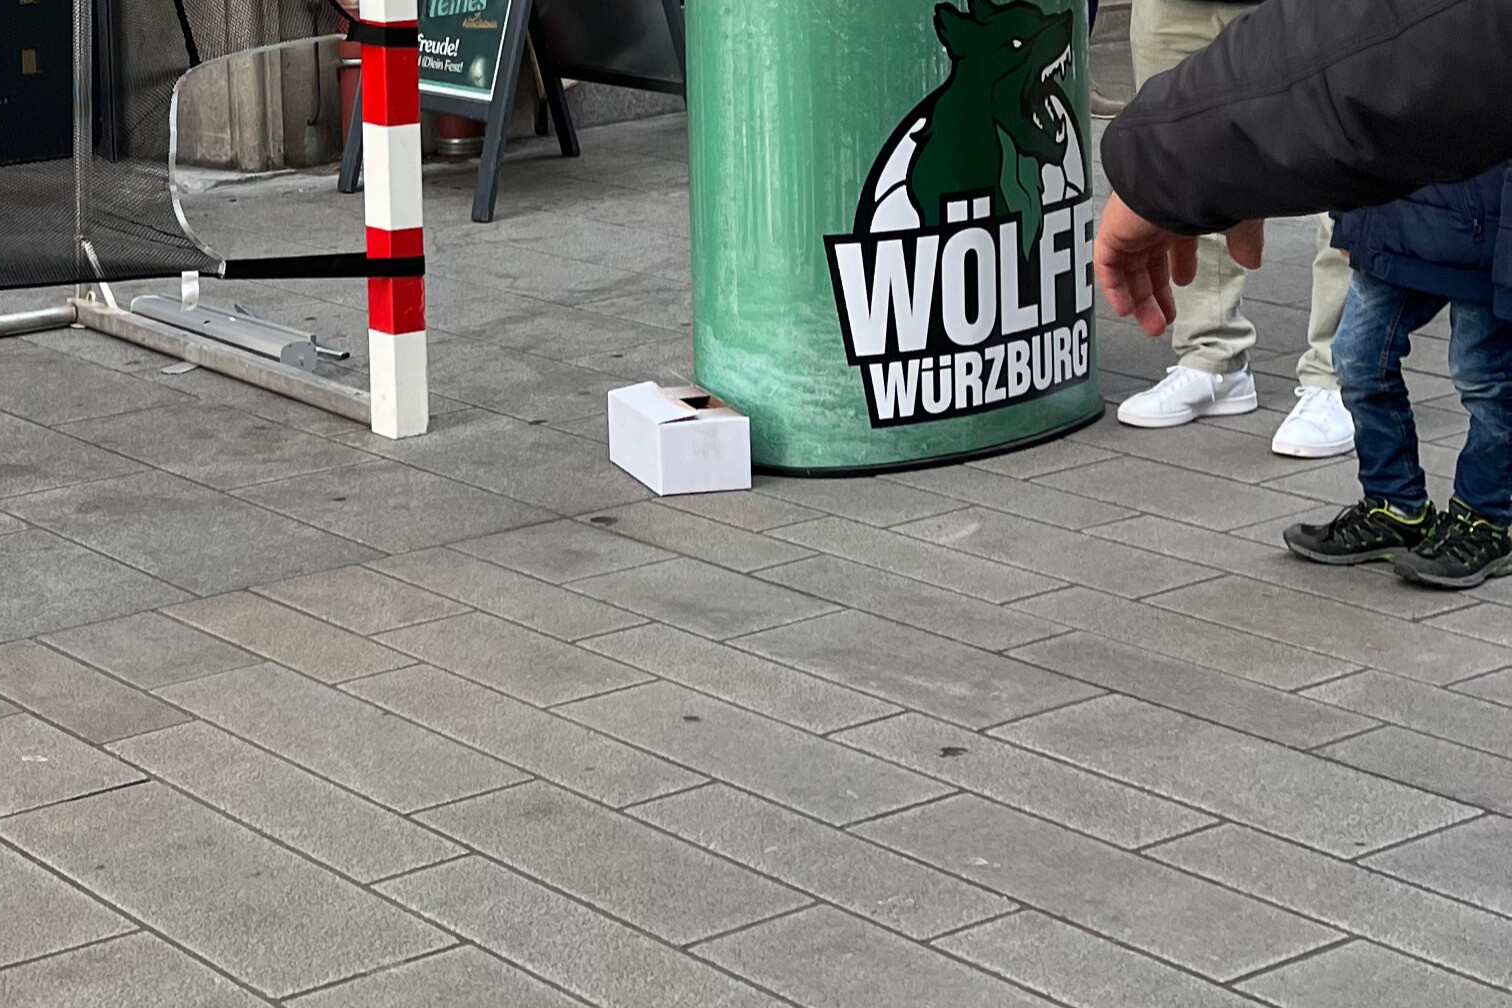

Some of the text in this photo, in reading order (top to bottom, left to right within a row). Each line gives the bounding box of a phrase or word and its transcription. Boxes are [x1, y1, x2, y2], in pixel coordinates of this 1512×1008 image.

[418, 33, 460, 57] freude!
[834, 195, 1093, 357] WÖLFE
[869, 319, 1088, 420] WÜRZBURG
